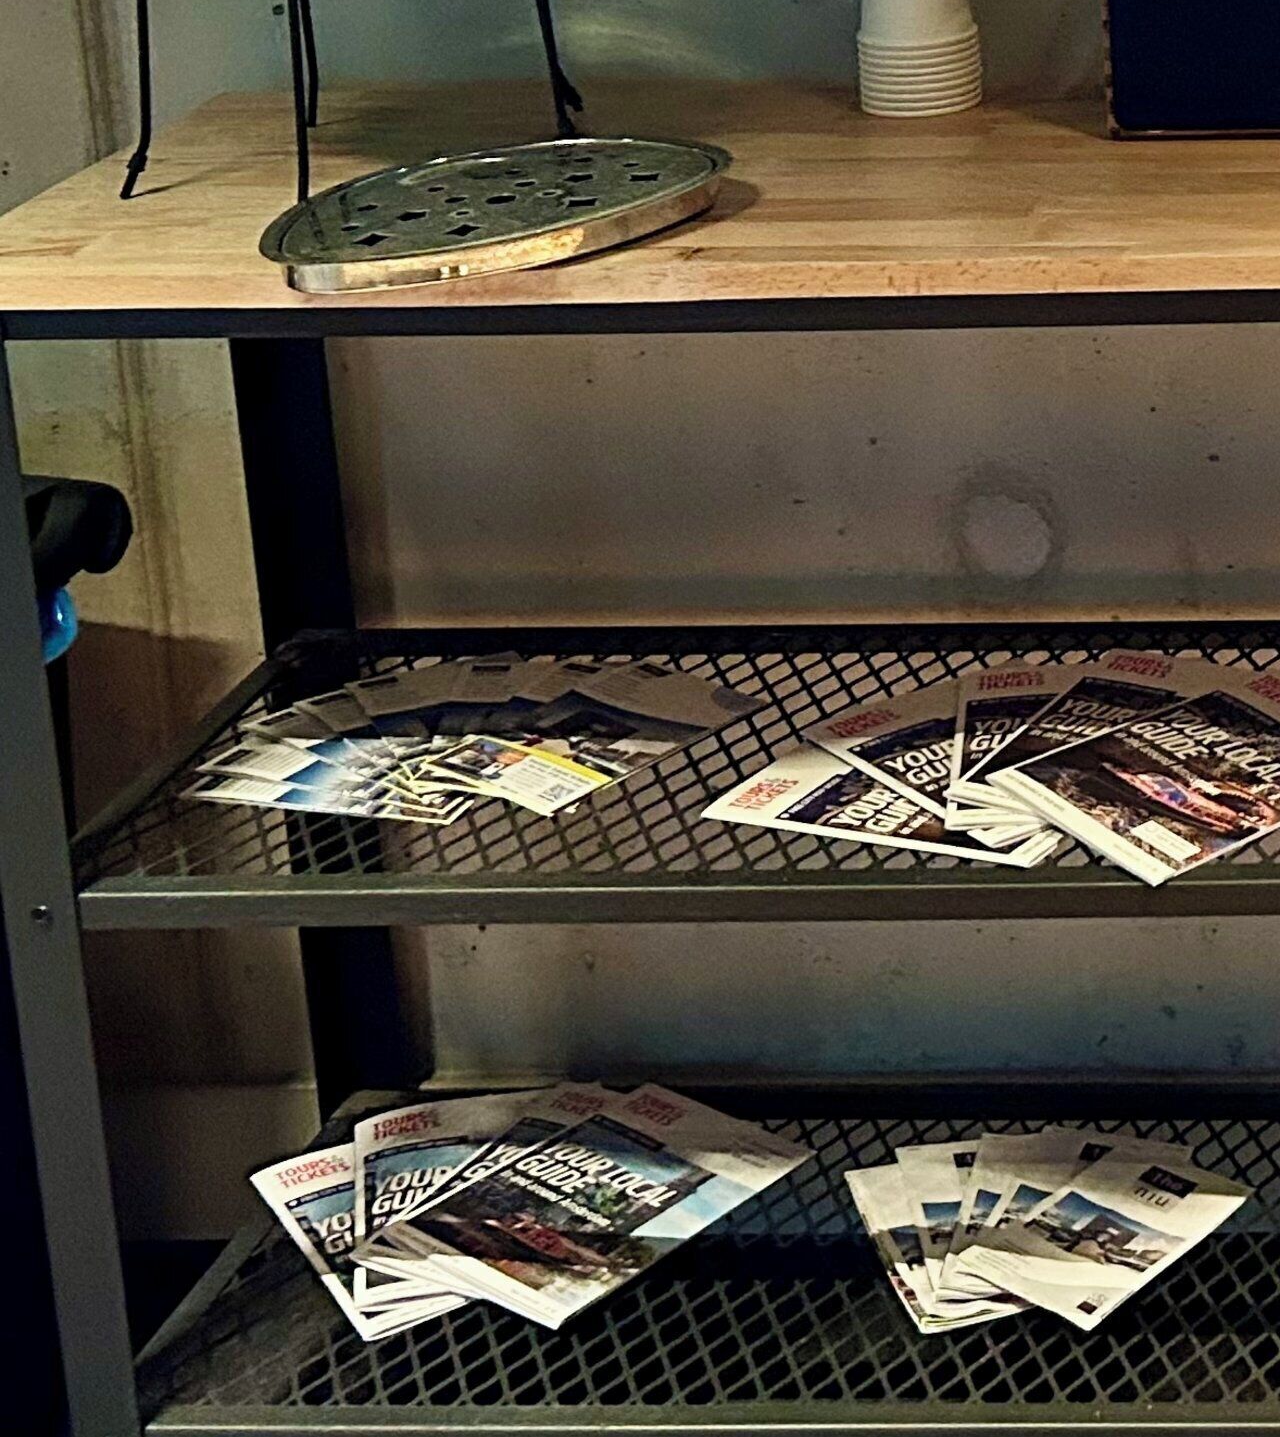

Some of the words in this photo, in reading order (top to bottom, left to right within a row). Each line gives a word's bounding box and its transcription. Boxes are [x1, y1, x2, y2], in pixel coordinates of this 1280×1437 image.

[1130, 721, 1209, 761] GUIDE
[1162, 709, 1226, 751] YOUR
[744, 778, 799, 810] TICKETS
[827, 787, 898, 828] YOUR
[281, 1163, 351, 1188] TICKETS
[515, 1154, 590, 1194] GUIDE
[545, 1141, 606, 1184] YOUR
[606, 1170, 678, 1208] LOCAL
